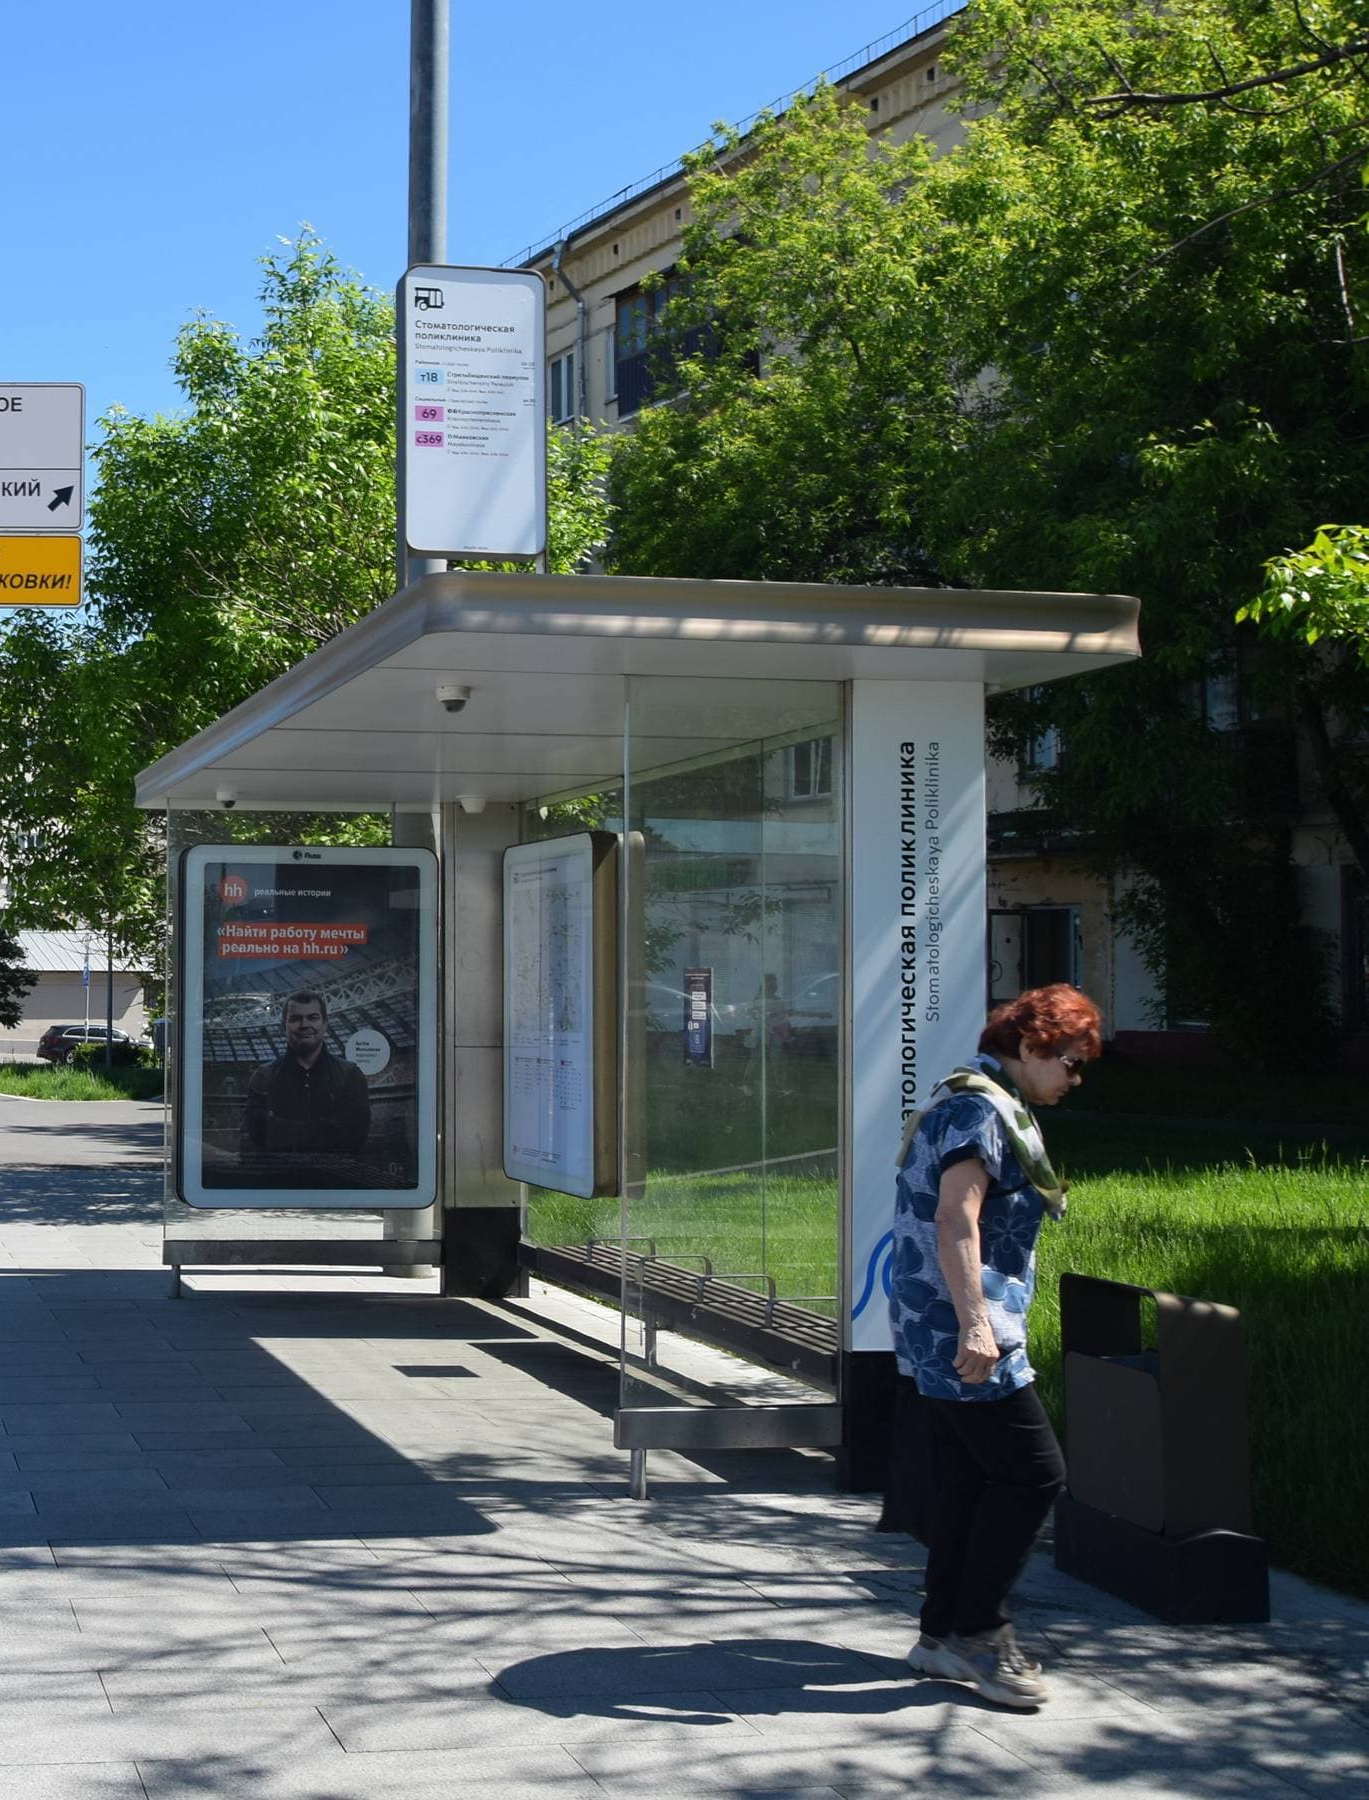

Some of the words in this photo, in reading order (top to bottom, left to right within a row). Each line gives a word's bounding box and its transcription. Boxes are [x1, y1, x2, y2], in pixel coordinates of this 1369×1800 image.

[415, 320, 515, 333] Стоматологическая
[415, 333, 481, 342] поликлиника
[421, 408, 437, 419] 69
[925, 741, 941, 830] Poliklinika
[901, 741, 916, 916] поликлиника
[224, 883, 242, 897] hh
[254, 888, 295, 898] реальные
[298, 889, 331, 898] истории
[217, 924, 267, 938] «Найти
[270, 926, 317, 941] работу
[320, 928, 365, 940] мечты
[926, 836, 943, 1022] Stomatologicheskaya
[222, 943, 280, 955] реально
[283, 944, 299, 954] на
[901, 925, 916, 1128] атологическая
